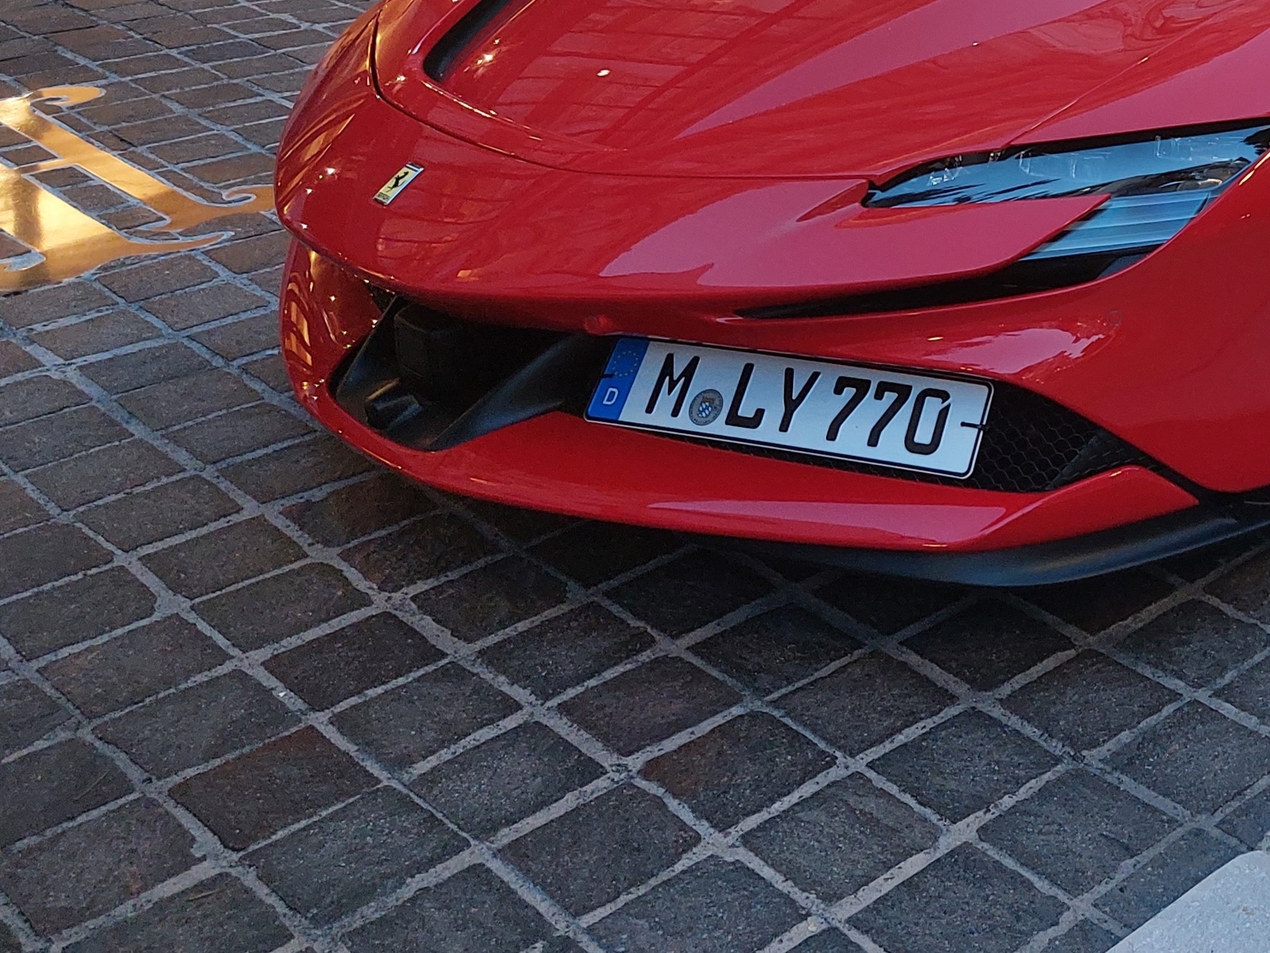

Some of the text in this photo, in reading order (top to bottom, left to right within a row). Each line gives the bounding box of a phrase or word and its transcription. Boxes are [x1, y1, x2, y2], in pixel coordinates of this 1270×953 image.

[602, 387, 619, 405] D
[645, 352, 701, 418] M
[724, 362, 822, 433] LY
[825, 375, 951, 456] 770
